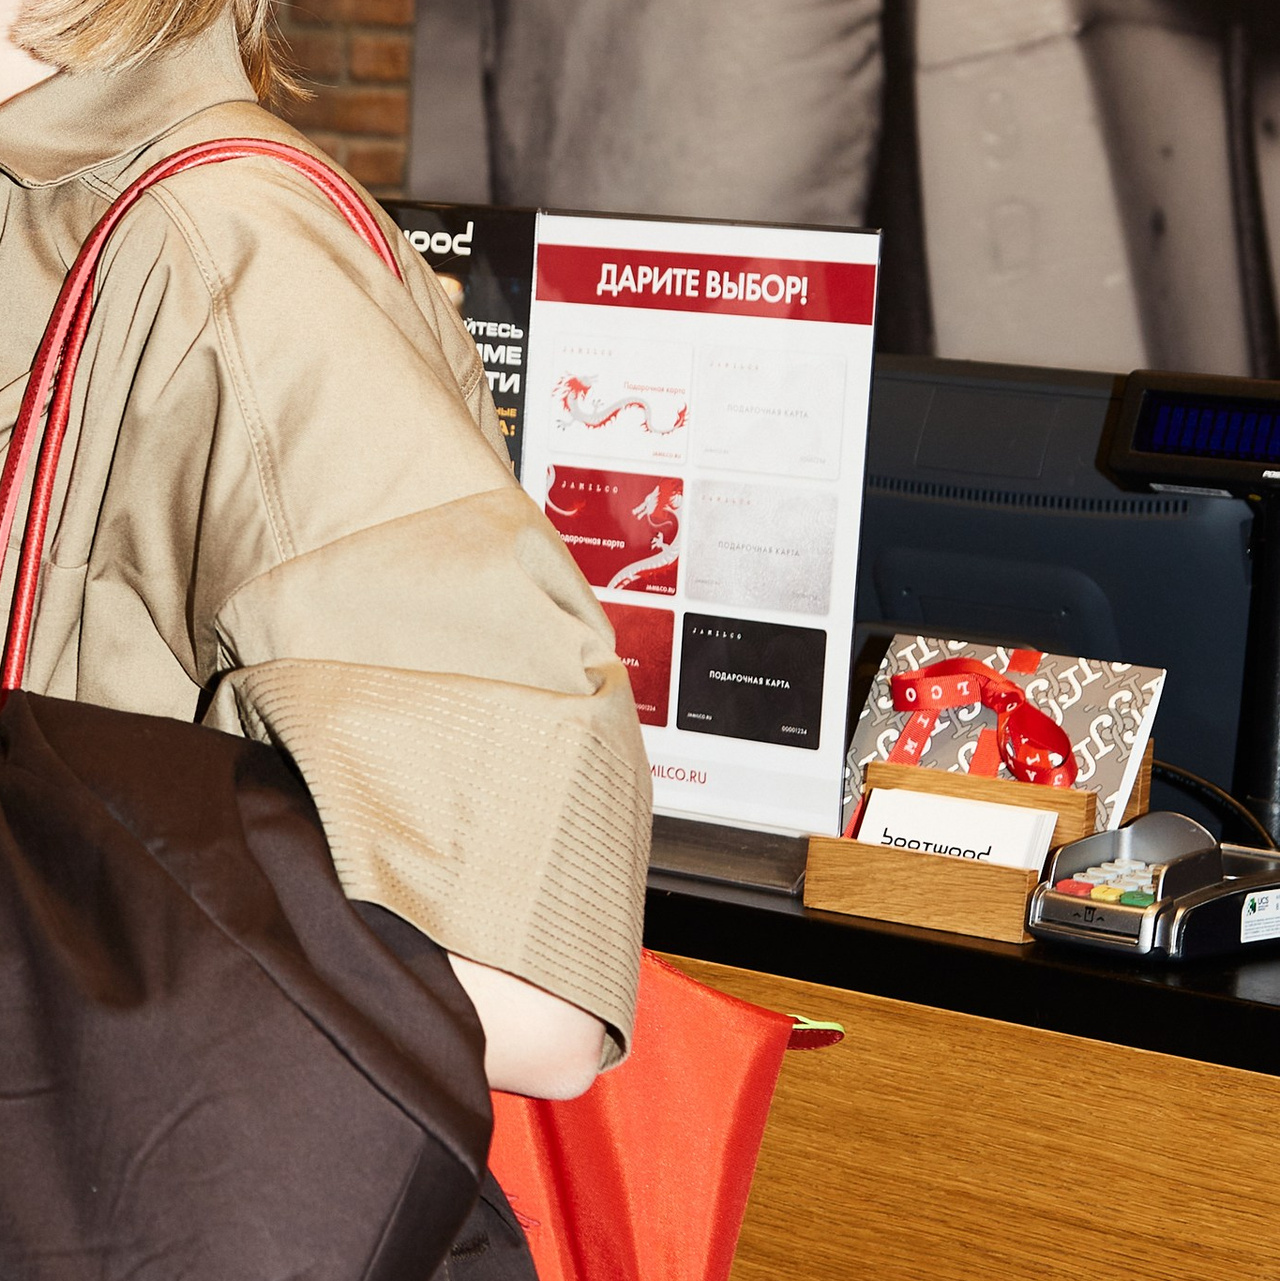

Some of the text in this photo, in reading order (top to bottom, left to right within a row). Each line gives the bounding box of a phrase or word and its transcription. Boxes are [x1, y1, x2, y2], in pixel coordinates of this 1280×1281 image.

[596, 263, 808, 305] ДАРИТЕ ВЫБОР!
[783, 409, 809, 419] КАРТА
[561, 480, 619, 494] JAMILCO
[601, 538, 625, 550] карта
[718, 540, 801, 558] ПОДАРОЧНАЯ КАРТА
[692, 626, 743, 640] JAMILCO
[709, 669, 791, 690] ПОДАРОЧНАЯ КАРТА
